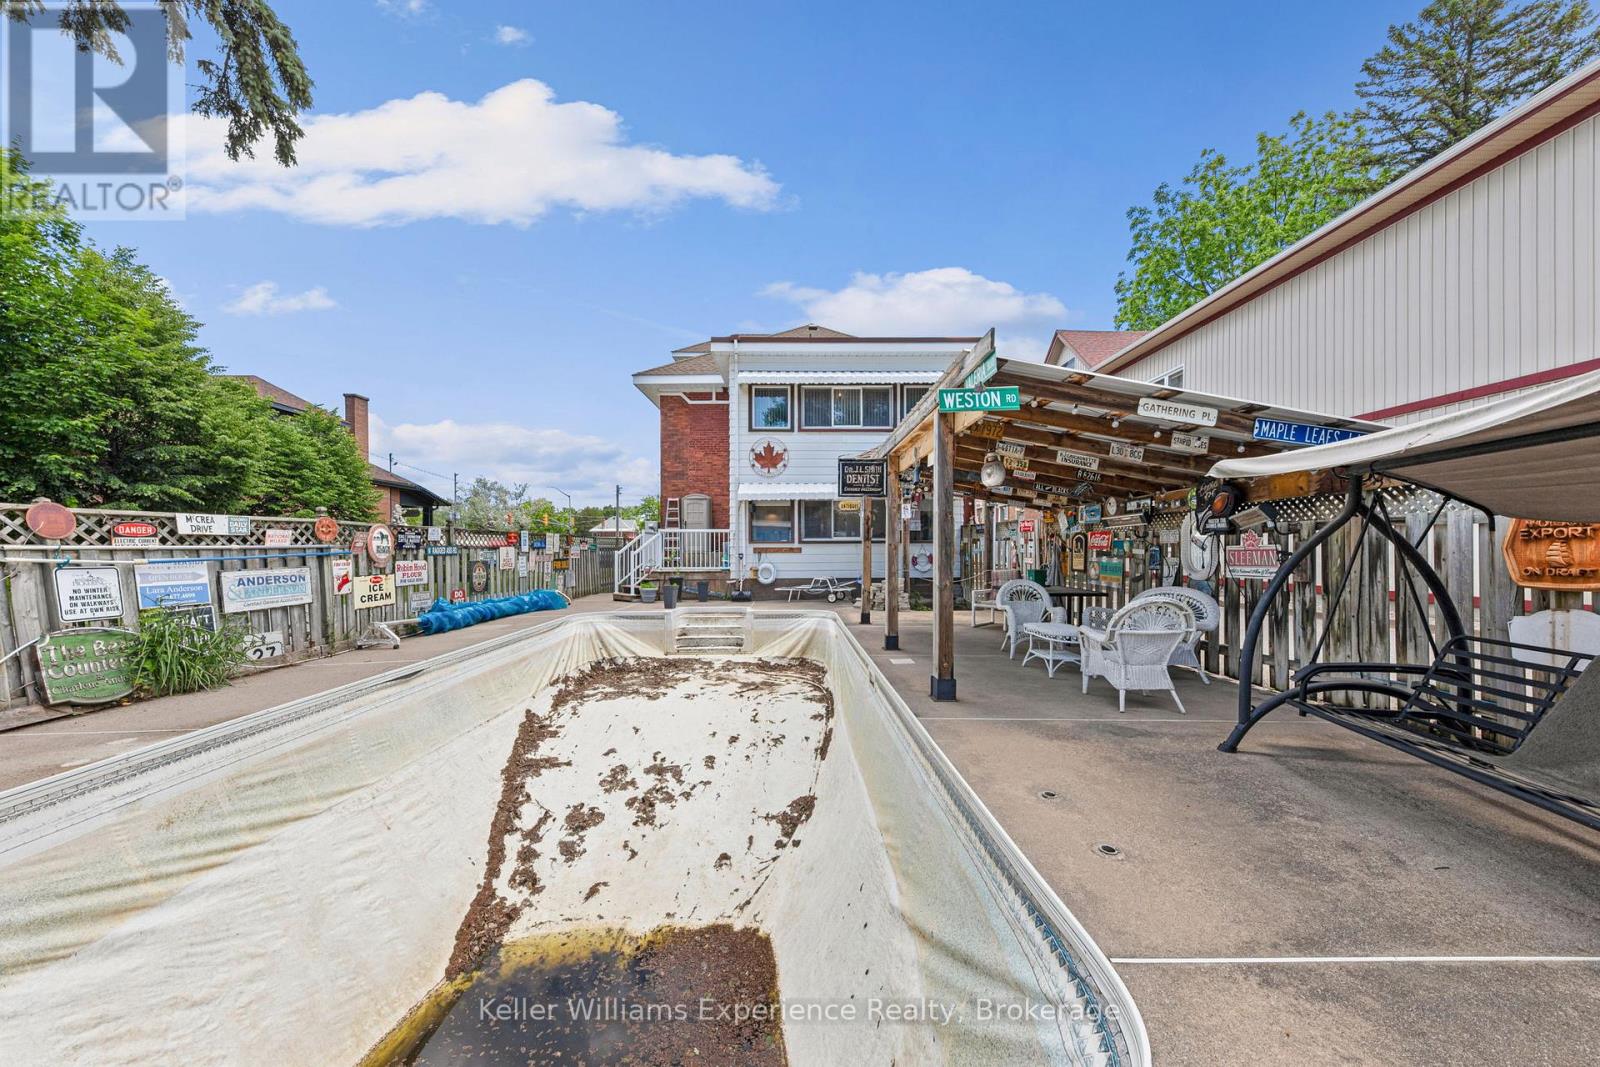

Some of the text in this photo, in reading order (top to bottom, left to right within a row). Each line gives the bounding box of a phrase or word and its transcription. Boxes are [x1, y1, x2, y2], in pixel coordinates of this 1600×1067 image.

[944, 391, 1017, 408] WESTON RD
[1143, 403, 1196, 419] GATHERING
[1260, 421, 1298, 440] MAPLE
[1305, 427, 1340, 444] LEAFS
[1061, 457, 1092, 468] INSURANCE
[846, 474, 880, 484] DENTIST
[119, 525, 153, 534] DANGER
[190, 524, 213, 533] DRIVE
[1520, 526, 1592, 540] EXPORT
[1230, 550, 1277, 565] SLEEMAN
[396, 562, 427, 572] Robin Hood
[1522, 567, 1594, 577] ON DRAFT
[237, 574, 306, 587] ANDERSON
[146, 585, 203, 595] Lara Anderson
[368, 583, 384, 593] ICE
[69, 593, 112, 601] MAINTENANCE
[360, 592, 392, 603] CREAM
[454, 590, 463, 598] DO
[43, 644, 86, 663] The
[252, 645, 276, 659] 27
[47, 658, 130, 679] Counter
